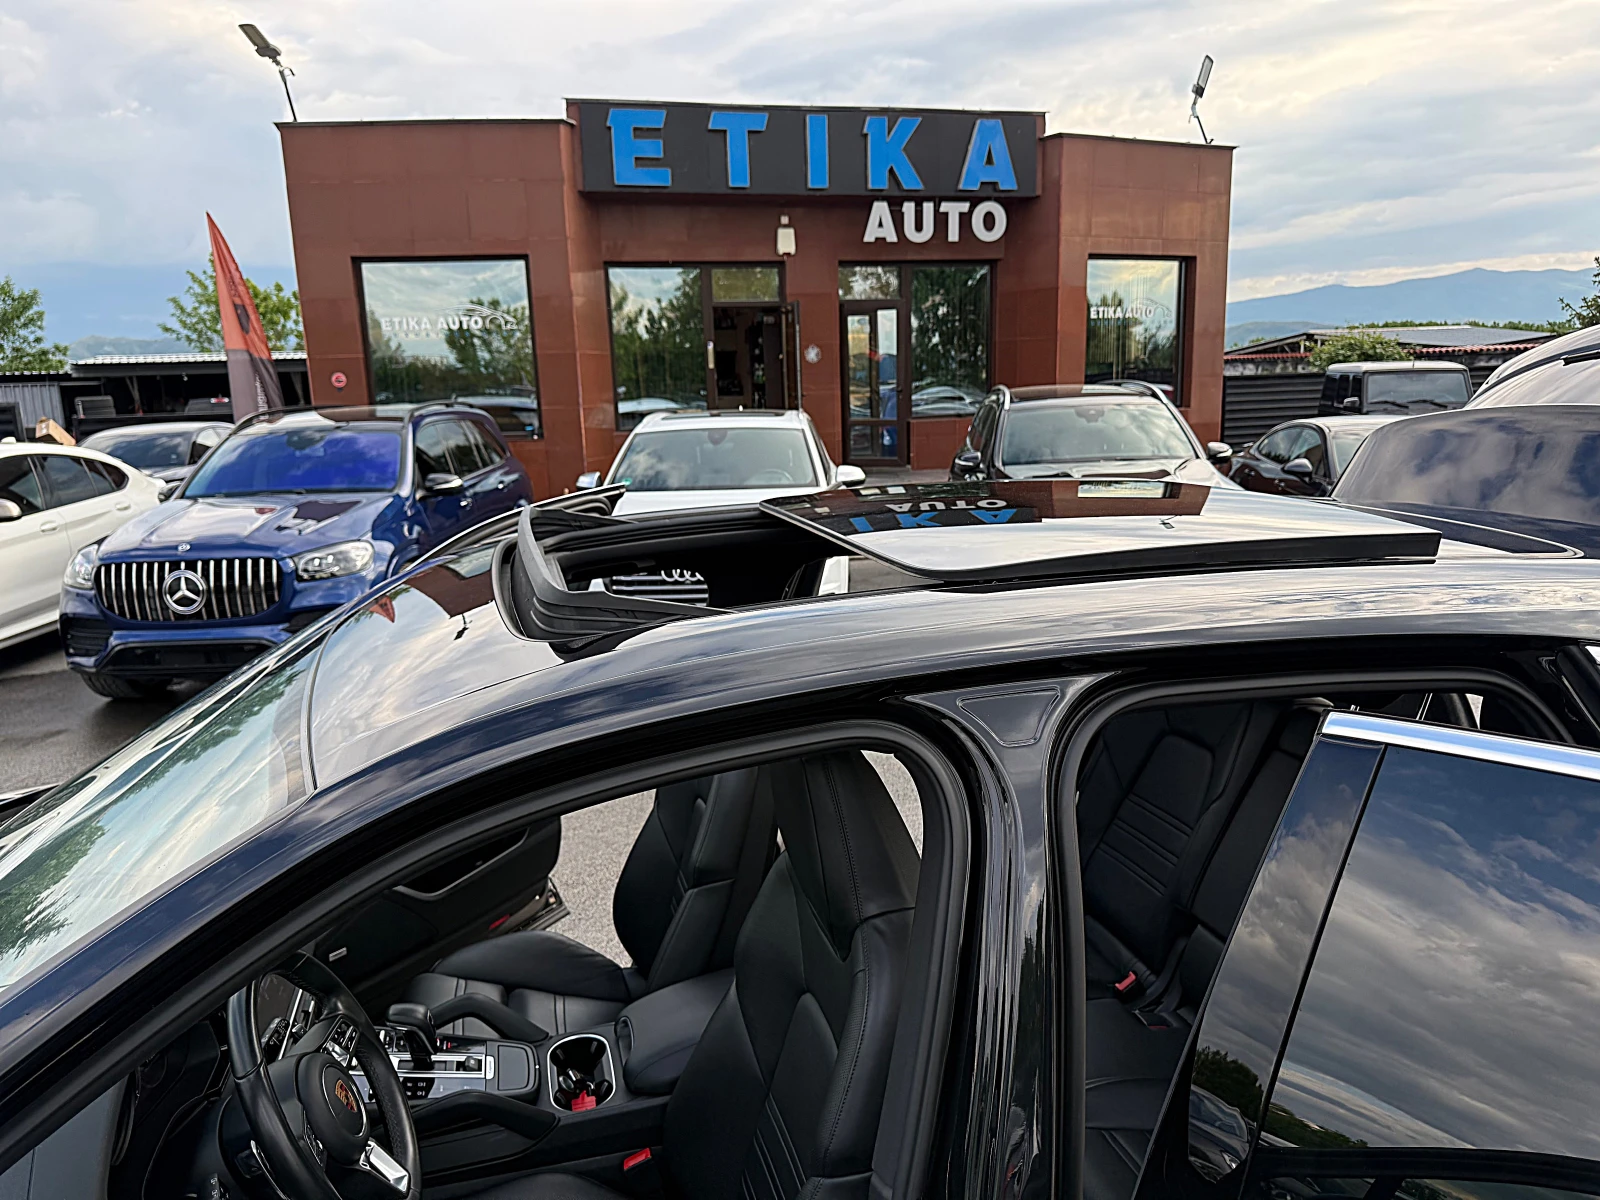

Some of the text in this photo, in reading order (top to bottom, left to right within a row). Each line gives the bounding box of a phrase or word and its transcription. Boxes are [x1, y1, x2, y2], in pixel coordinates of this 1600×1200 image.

[606, 108, 1018, 191] ETIKA
[863, 200, 1008, 244] AUTO
[381, 315, 483, 331] ETIKA AUTO
[1089, 305, 1154, 319] ETIKA AUTO
